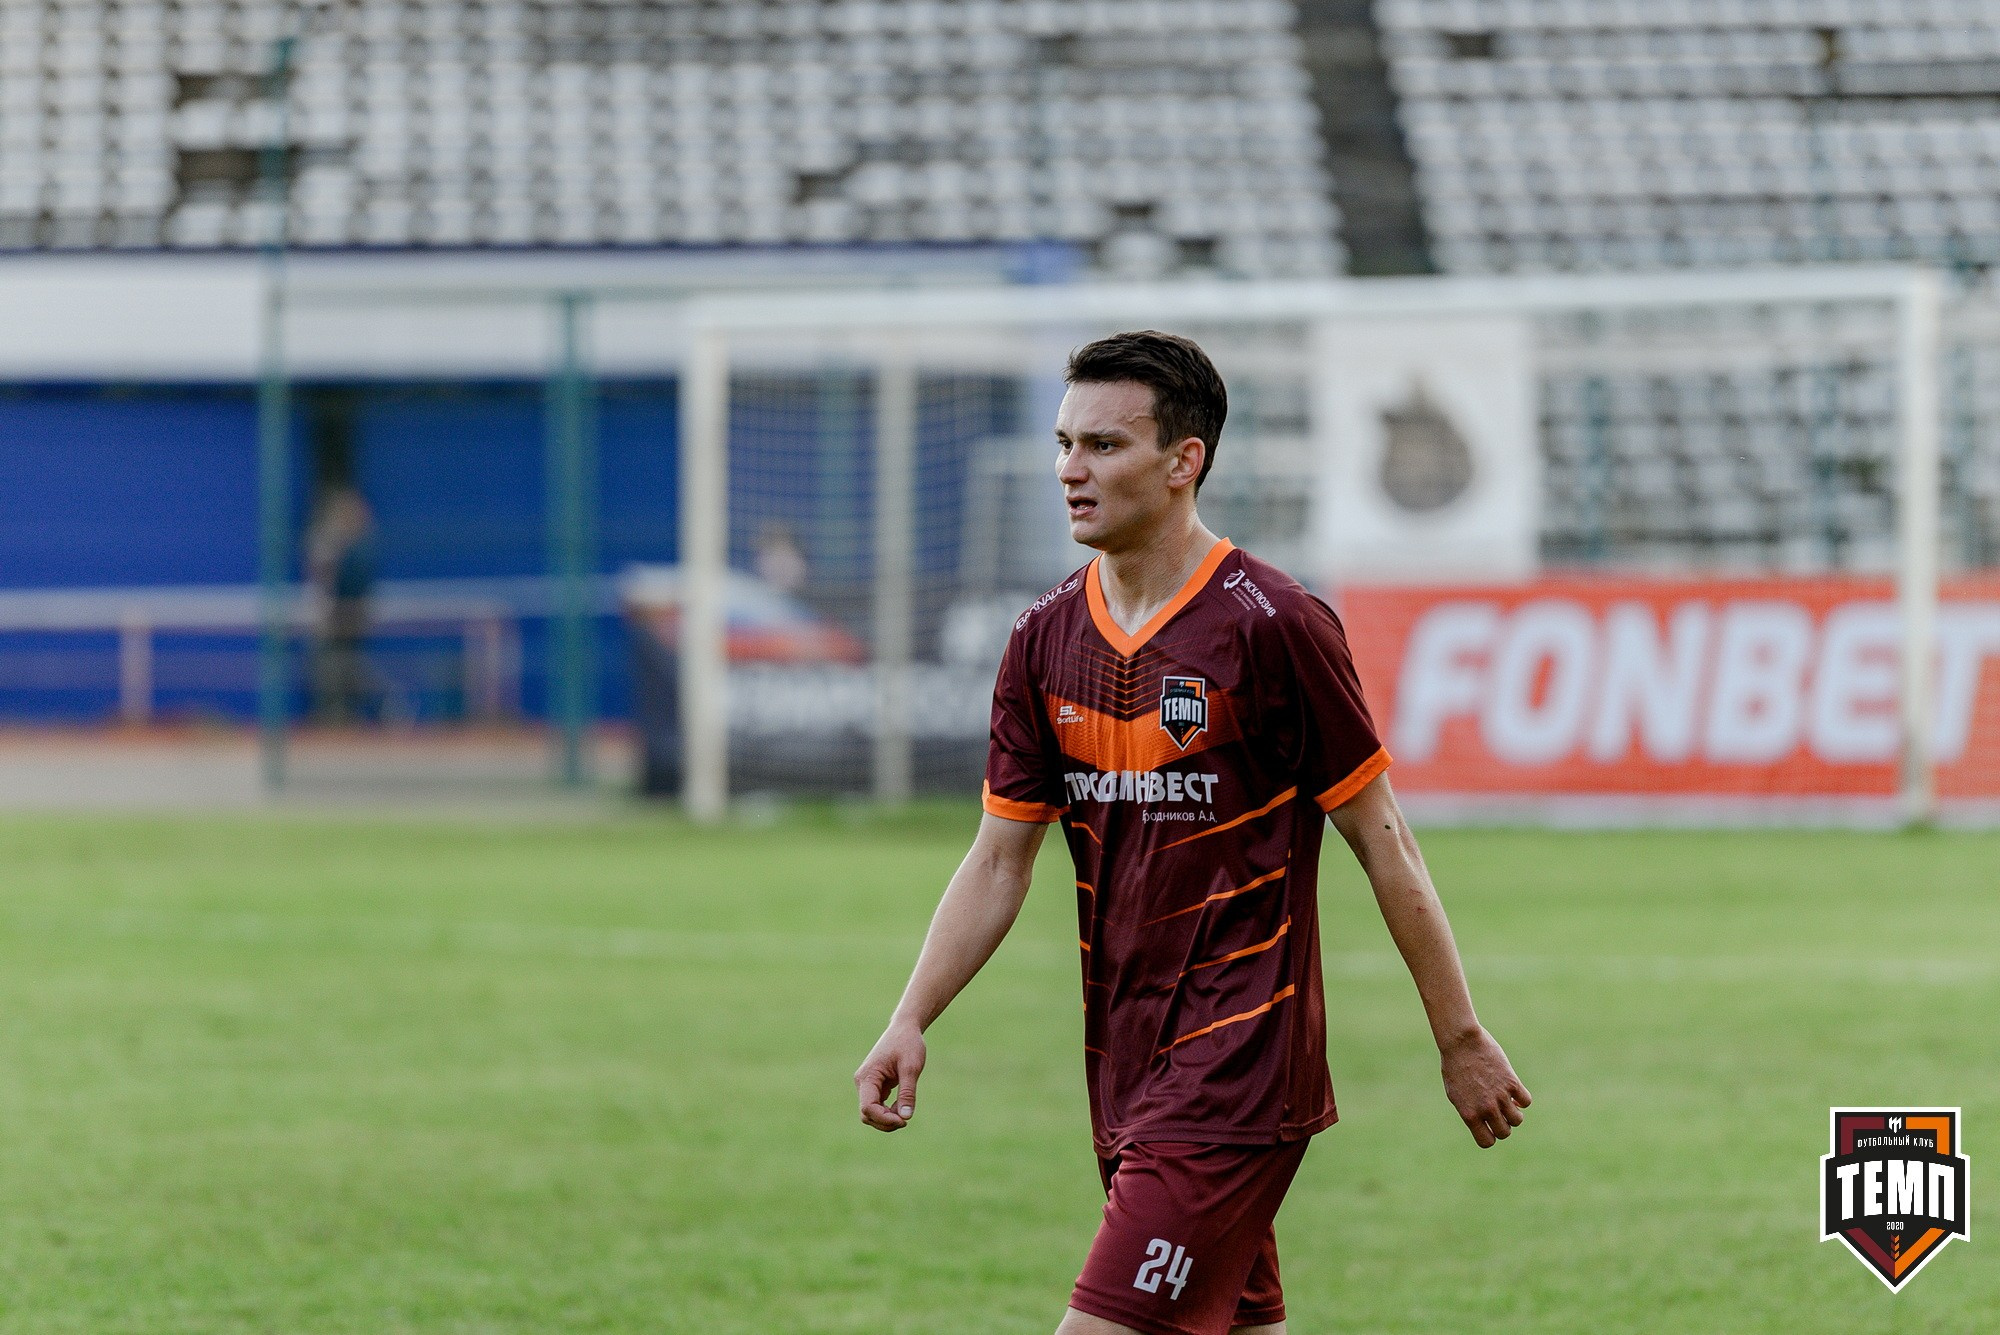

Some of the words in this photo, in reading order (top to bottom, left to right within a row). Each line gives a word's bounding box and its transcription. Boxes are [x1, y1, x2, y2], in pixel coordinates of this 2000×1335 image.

[1241, 578, 1277, 618] ЭКСКЛЮЗИВ
[1164, 697, 1203, 724] ТЕМП
[1133, 1238, 1194, 1300] 24
